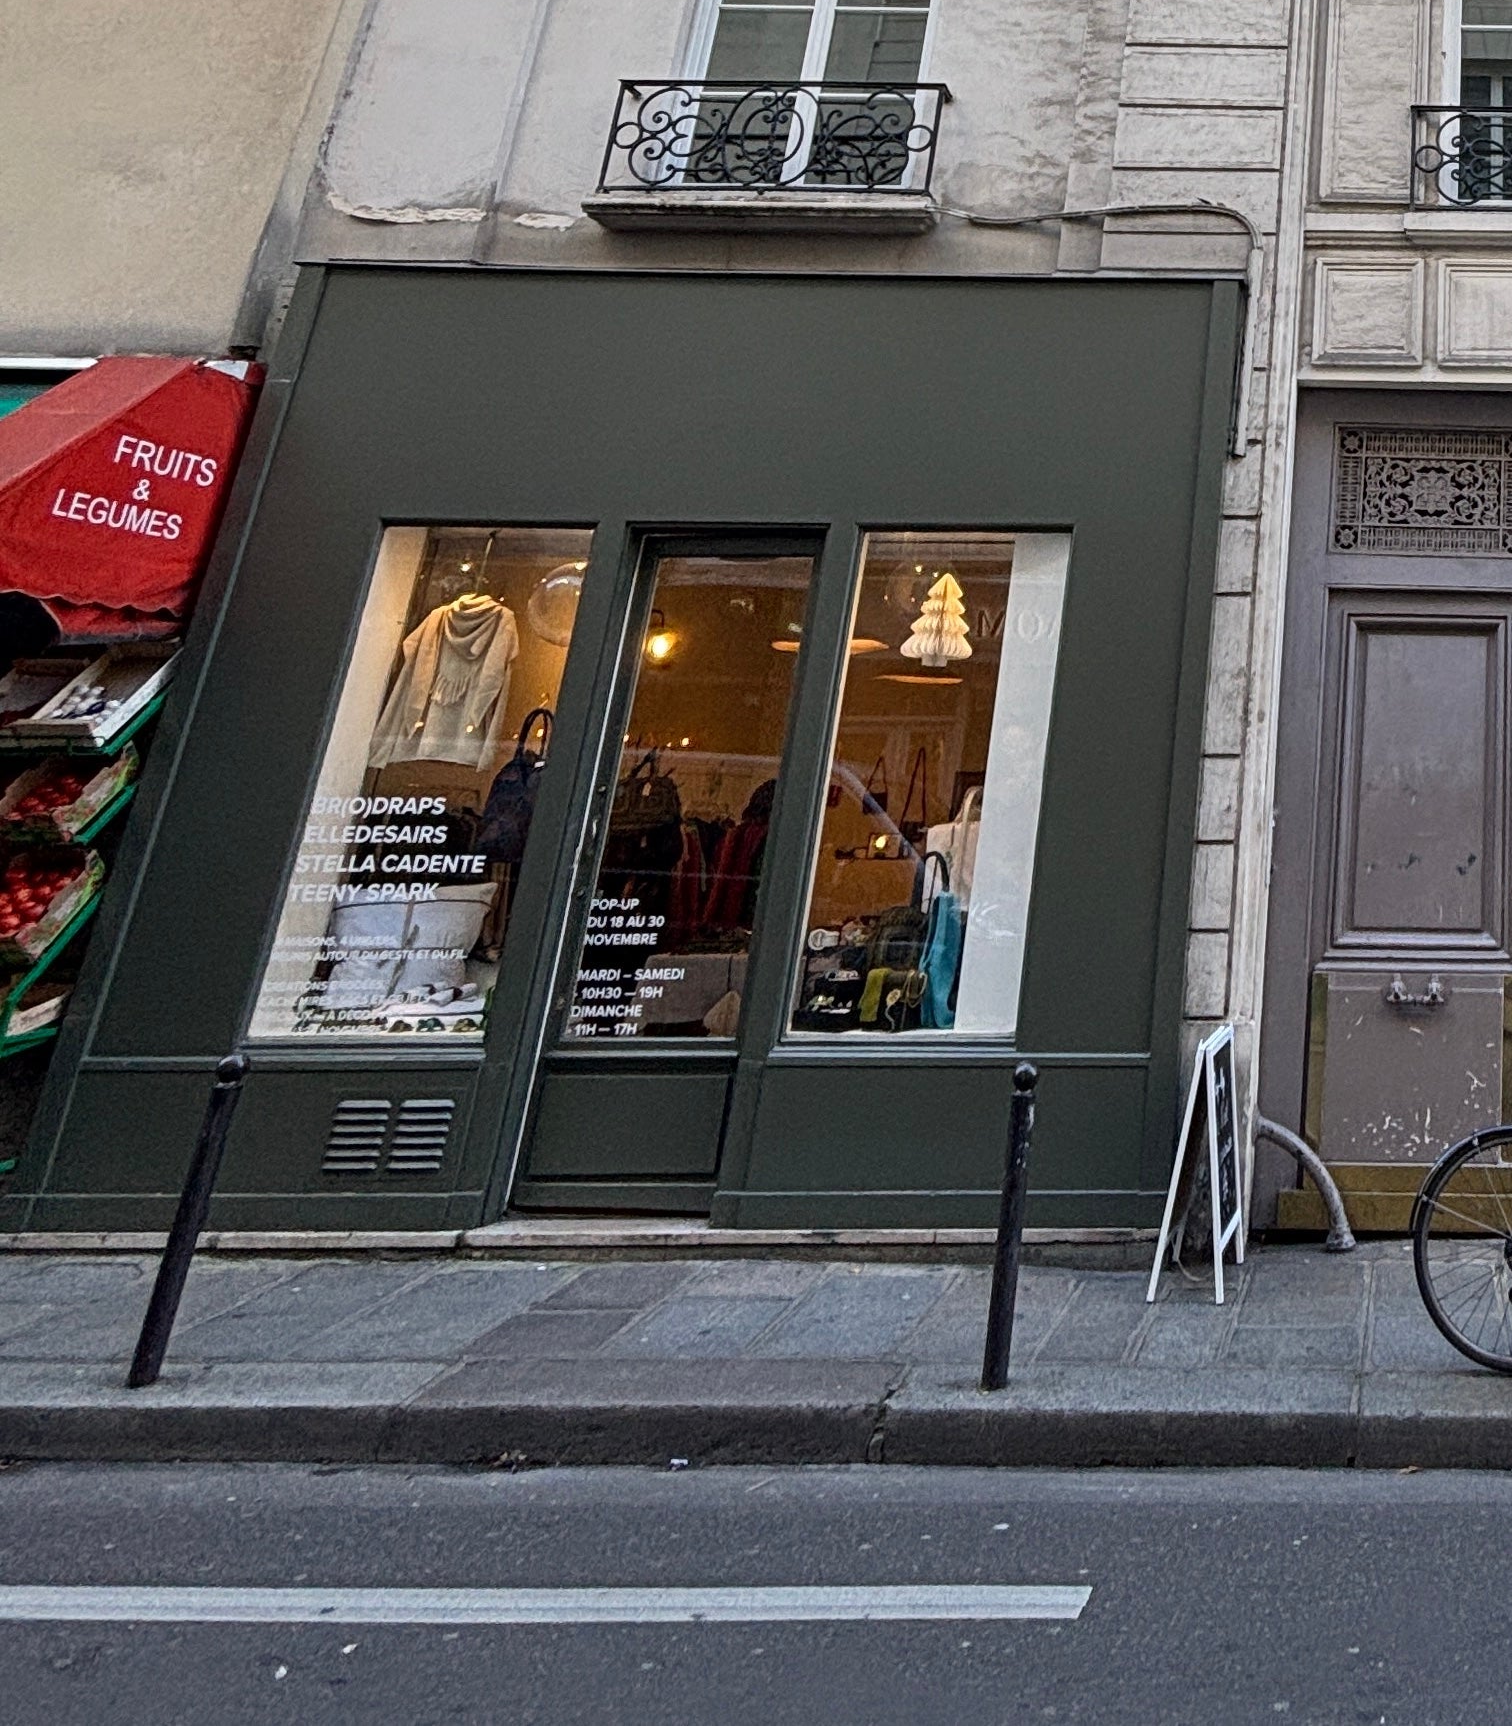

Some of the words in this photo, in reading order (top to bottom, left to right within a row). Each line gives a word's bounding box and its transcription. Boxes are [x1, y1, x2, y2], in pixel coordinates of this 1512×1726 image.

[113, 434, 218, 487] FRUITS
[132, 478, 151, 501] &
[51, 488, 183, 540] LEGUMES
[312, 796, 447, 819] BR(O)DRAPS
[303, 824, 448, 844] ELLEDESAIRS
[295, 854, 376, 873] STELLA
[380, 853, 487, 874] CADENTE
[288, 883, 363, 903] TEENY
[366, 882, 440, 901] SPARK
[590, 899, 639, 910] POP-UP
[587, 917, 606, 928] DU
[610, 916, 624, 927] 18
[626, 916, 646, 927] AU
[648, 916, 665, 927] 30
[583, 933, 658, 945] NOVEMBRE
[577, 969, 621, 981] MARDI
[634, 968, 685, 980] SAMEDI
[581, 987, 622, 999] 10H30
[639, 986, 663, 998] 19H
[571, 1005, 643, 1017] DIMANCHE
[574, 1024, 597, 1036] 11H
[613, 1023, 638, 1035] 17H
